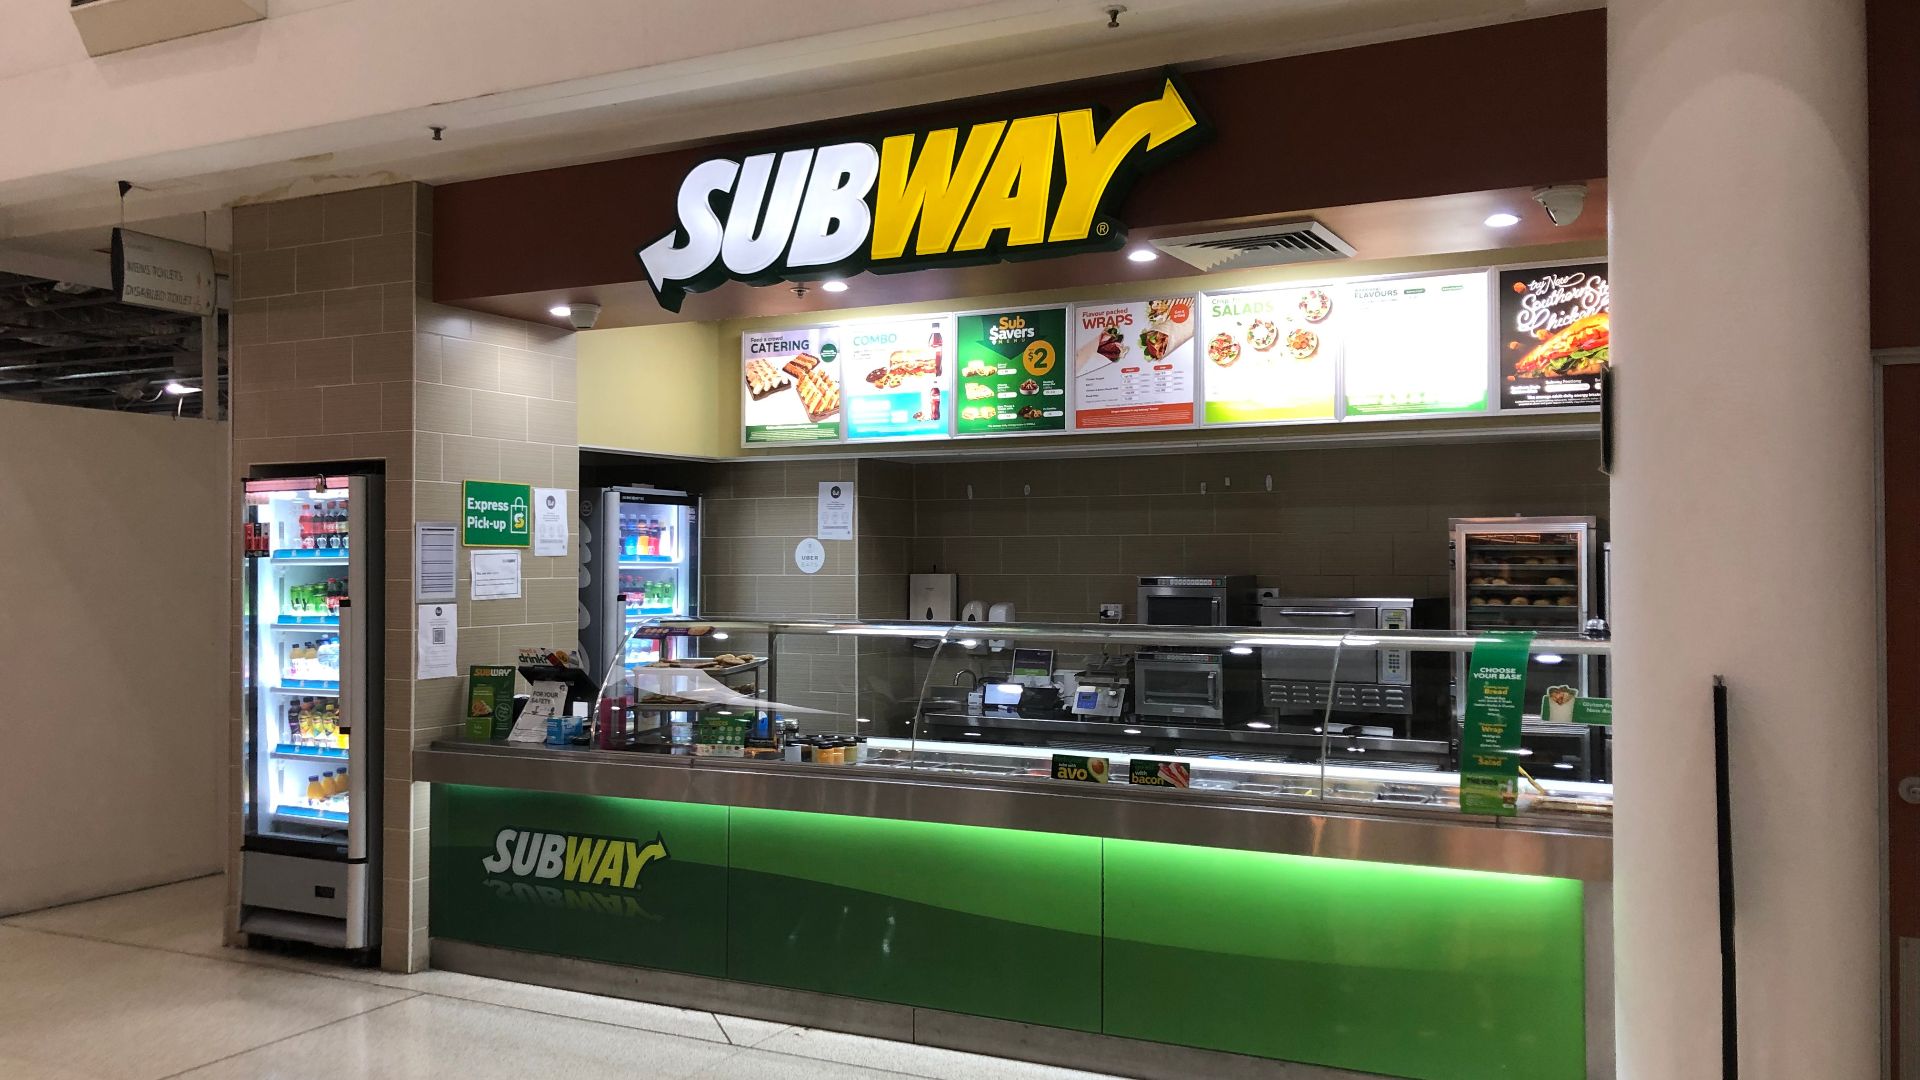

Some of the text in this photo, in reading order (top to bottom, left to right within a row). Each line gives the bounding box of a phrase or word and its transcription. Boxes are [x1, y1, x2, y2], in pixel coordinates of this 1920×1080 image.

[639, 79, 1197, 293] SUBWAY
[1354, 289, 1398, 299] FLAVOURS
[1106, 308, 1128, 316] packed
[1212, 303, 1274, 317] SALADS
[999, 315, 1026, 329] Sub
[1082, 314, 1133, 329] WRAPS
[853, 333, 897, 346] COMBO
[751, 340, 809, 353] CATERING
[467, 497, 509, 512] Express
[467, 516, 507, 532] Pick-up
[519, 653, 547, 663] drink?
[473, 668, 512, 677] SUBWAY
[1481, 725, 1504, 734] Wrap
[1057, 766, 1088, 780] avo
[1131, 773, 1164, 785] bacon
[482, 829, 667, 889] SUBWAY
